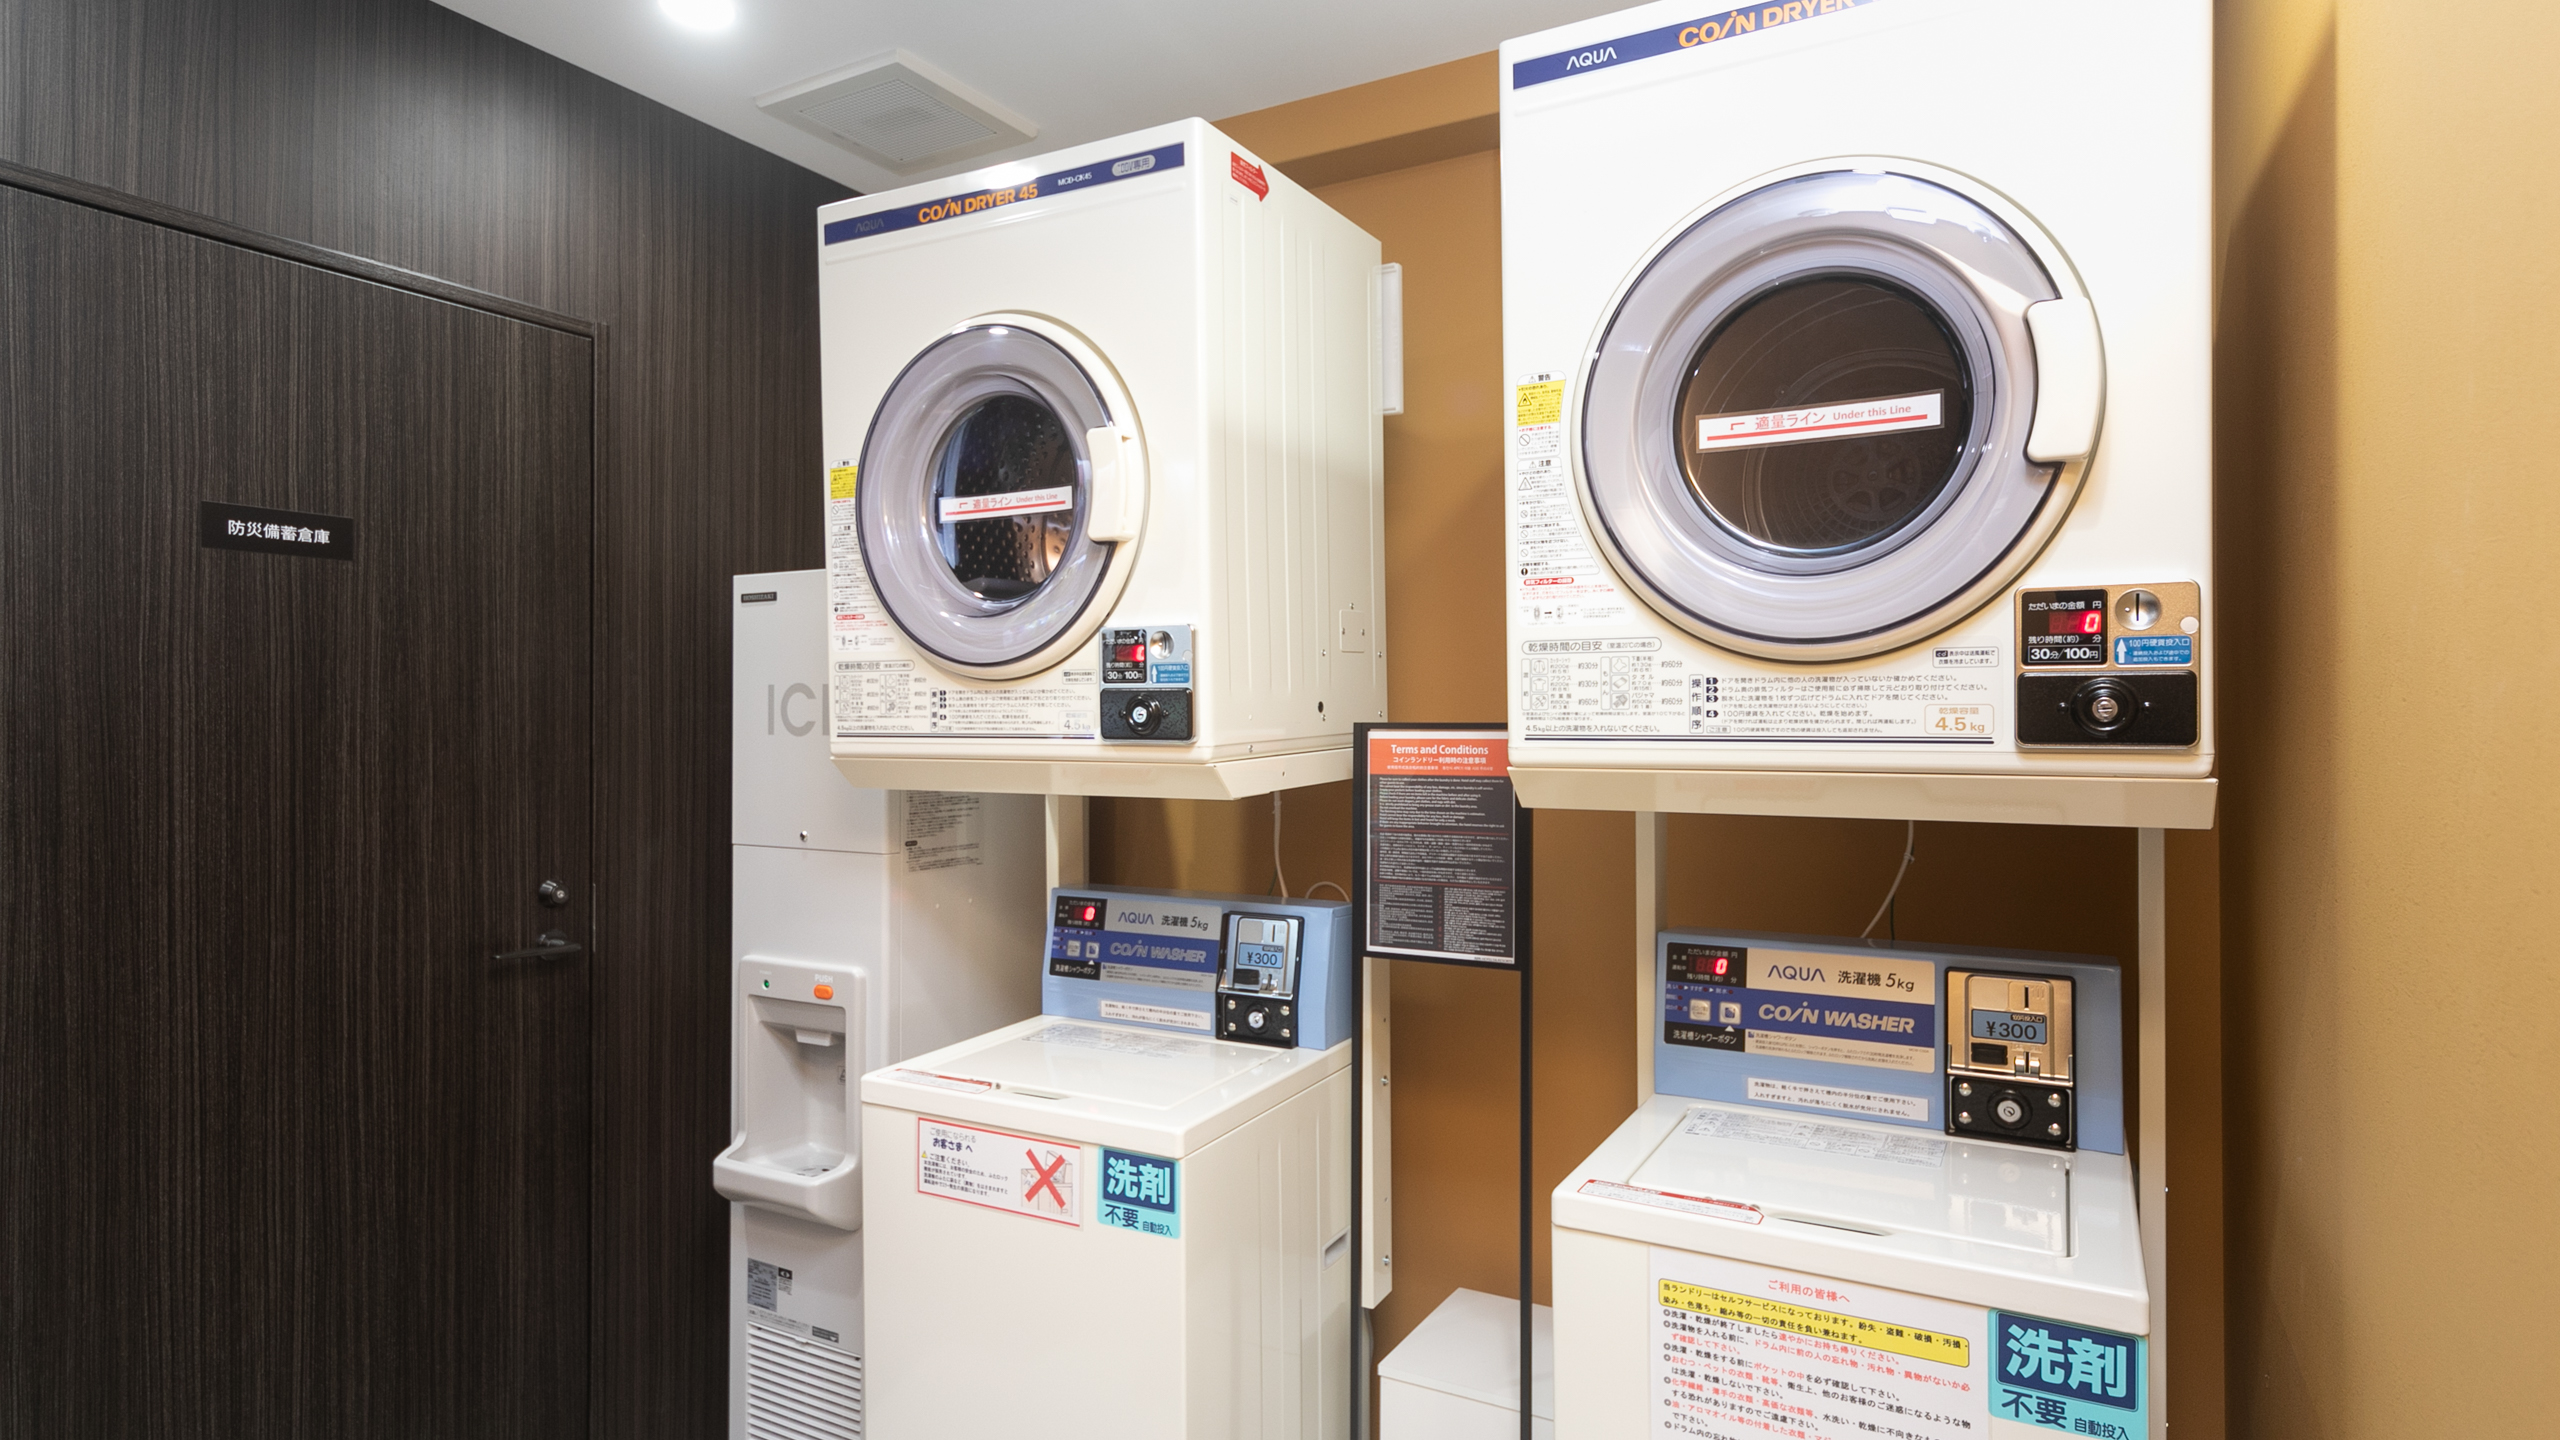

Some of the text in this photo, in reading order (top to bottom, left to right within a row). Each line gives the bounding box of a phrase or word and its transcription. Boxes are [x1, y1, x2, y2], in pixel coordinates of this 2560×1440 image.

[1566, 47, 1617, 71] AQUA
[964, 190, 1015, 214] DRYER
[1019, 183, 1039, 200] 45
[855, 218, 885, 234] AQUA
[1754, 404, 1911, 431] 適量ライン Under this Line
[973, 497, 1013, 509] 適量ライン
[1016, 496, 1033, 504] Under
[1046, 493, 1058, 501] Line
[227, 519, 331, 545] 防災備蓄倉庫
[2028, 601, 2102, 611] ただいまの金額 円
[2084, 613, 2100, 632] 0
[1528, 641, 1602, 652] 乾燥時間の目安
[2092, 635, 2102, 643] 分
[2129, 638, 2190, 647] 100円硬貨投入口
[767, 682, 828, 737] IC
[1691, 678, 1702, 730] 操作順序
[1939, 707, 1979, 715] 乾燥容量
[1935, 717, 1985, 733] 4.5 kg
[1391, 744, 1488, 755] Terms and Conditions
[1118, 911, 1155, 926] AQUA
[1161, 915, 1188, 928] 洗濯機
[1151, 946, 1207, 964] WASHER
[1247, 951, 1278, 966] ¥300
[1715, 958, 1728, 975] 0
[1767, 964, 1825, 983] AQUA
[814, 974, 834, 983] PUSH
[1838, 969, 1881, 987] 洗濯機
[1825, 1009, 1914, 1034] WASHER
[1986, 1021, 2037, 1040] ¥300
[1672, 1029, 1737, 1045] 洗濯槽シャワーボタン
[930, 1153, 970, 1167] ご注意ください。
[1107, 1157, 1170, 1205] 洗剤
[1105, 1204, 1173, 1236] 不要 自動投入
[1768, 1280, 1850, 1303] ご利用の皆様へ
[1663, 1296, 1862, 1344] 染み・色落ち・縮み等の一切の責任を負い兼ねます。
[1671, 1333, 1740, 1355] ず確認して下さい。
[2006, 1324, 2127, 1398] 洗剤
[1672, 1367, 1783, 1400] は洗濯・乾燥しないで下さい。
[1672, 1390, 1818, 1431] する恐れがありますのでご遠慮下さい。
[1672, 1412, 1708, 1427] で下さい。
[2001, 1388, 2129, 1440] 不要 自動投入
